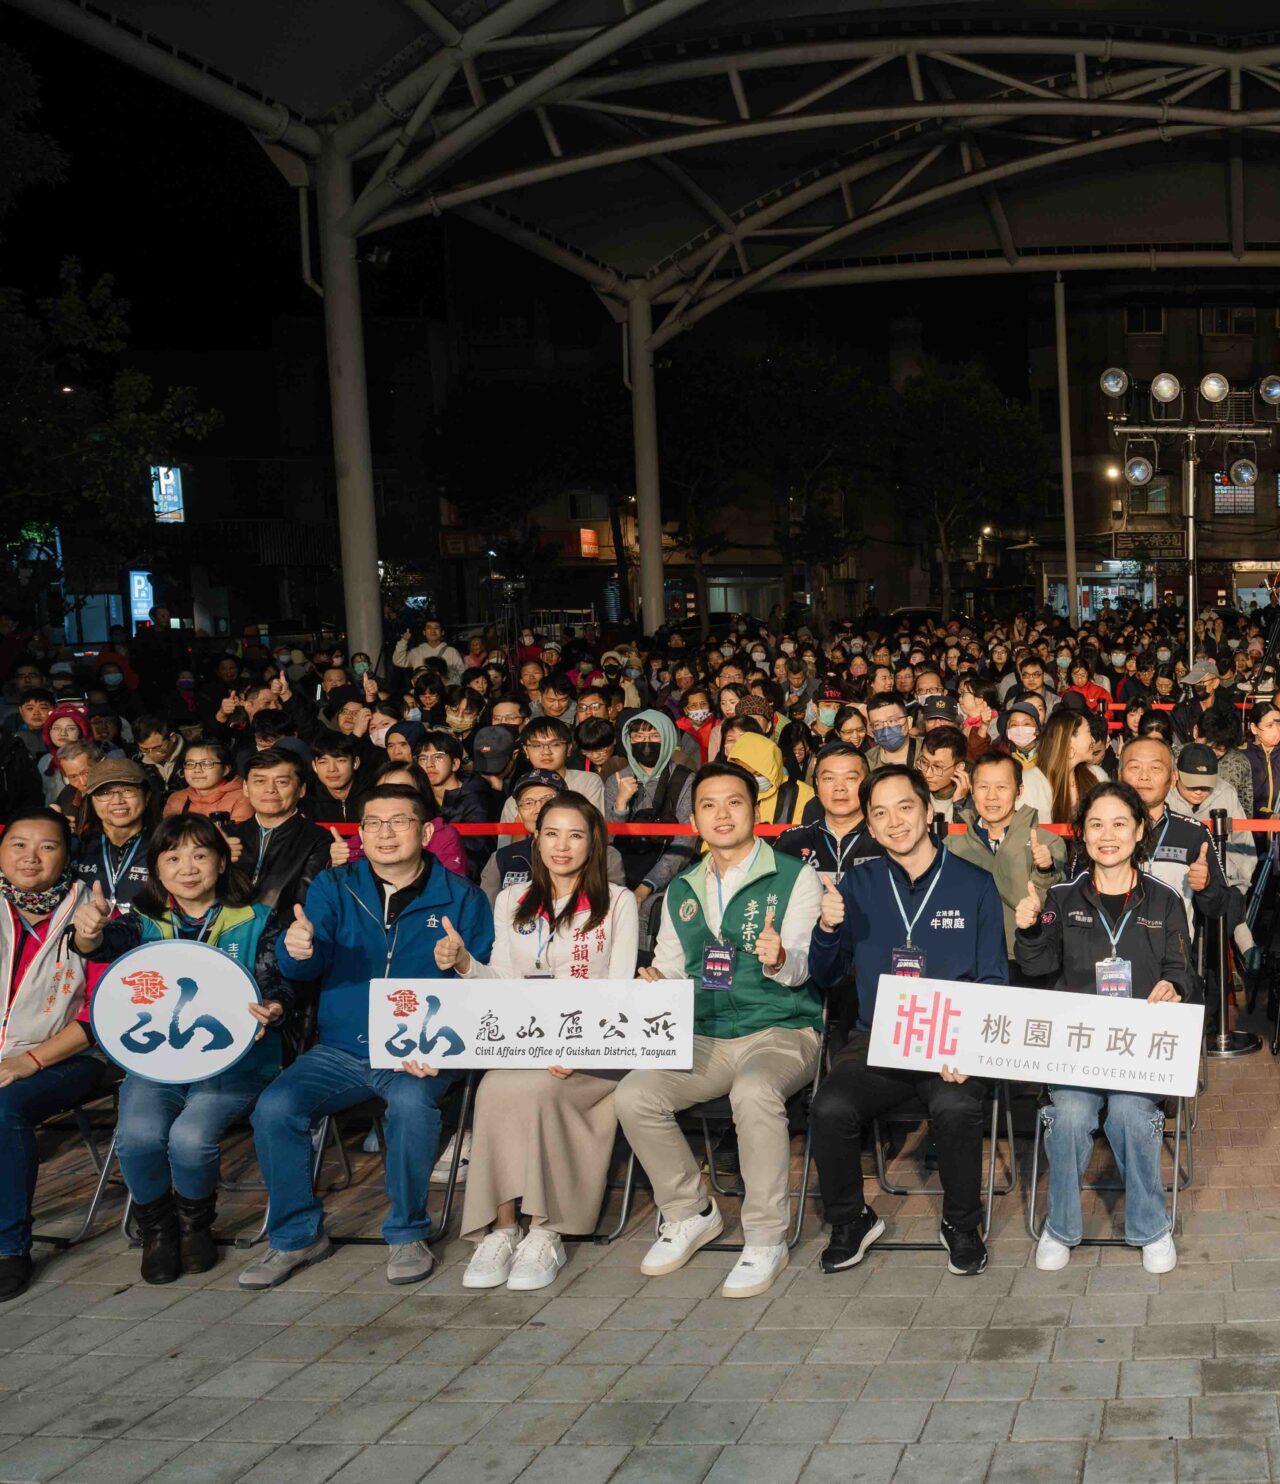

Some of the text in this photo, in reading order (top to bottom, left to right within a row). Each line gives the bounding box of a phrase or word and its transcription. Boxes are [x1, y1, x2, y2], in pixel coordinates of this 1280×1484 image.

[159, 466, 174, 494] P
[133, 575, 145, 598] P
[930, 918, 965, 929] 牛煦庭
[980, 1013, 1180, 1062] 桃園市政府
[475, 1046, 677, 1058] Civil Affairs Office of Guishan District, Taoyuan
[978, 1055, 1176, 1084] TAOYUAN CITY GOVERNMENT
